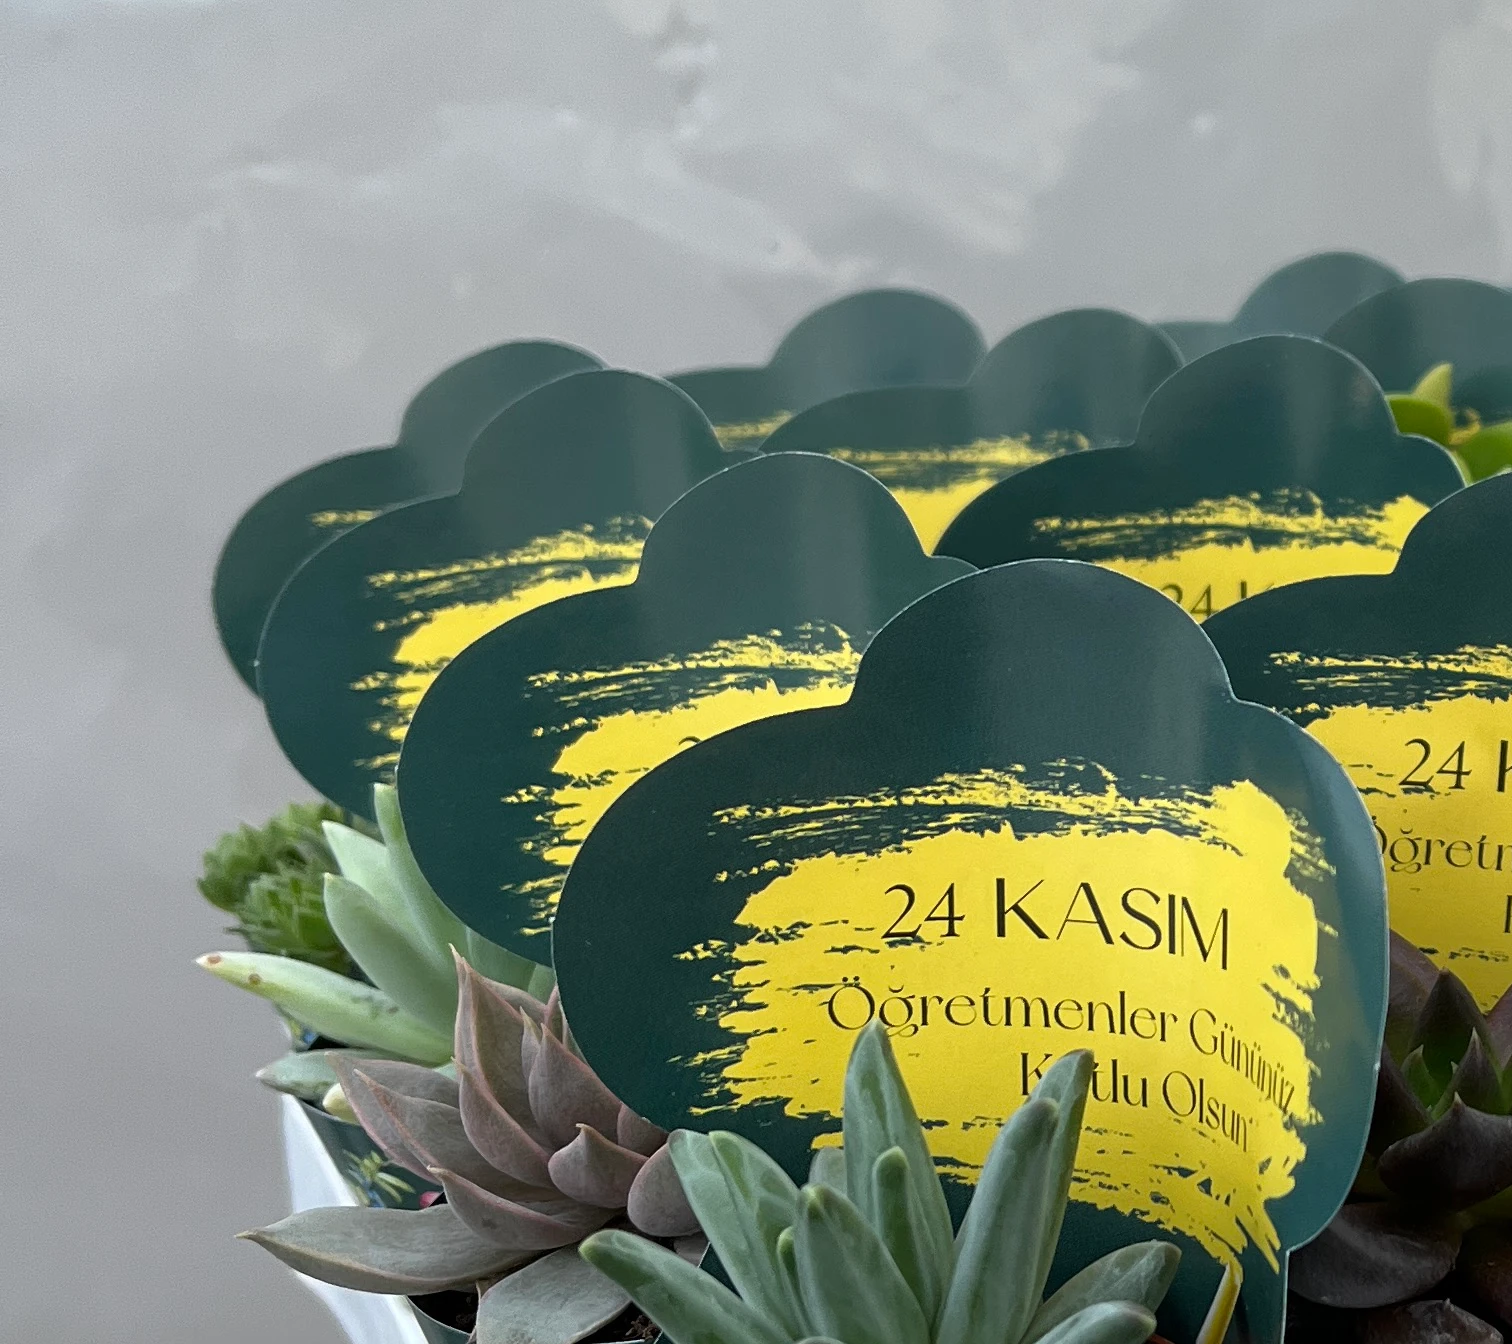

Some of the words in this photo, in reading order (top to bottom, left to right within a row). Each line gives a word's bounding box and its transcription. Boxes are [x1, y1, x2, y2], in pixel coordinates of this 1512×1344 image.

[1398, 738, 1472, 790] 24
[881, 883, 966, 939] 24
[996, 877, 1228, 970] KASIM
[828, 975, 1178, 1042] Öğretmenler
[1189, 1008, 1295, 1115] Gününüz
[1020, 1052, 1148, 1108] Ktlu
[1162, 1070, 1248, 1153] Olsun
